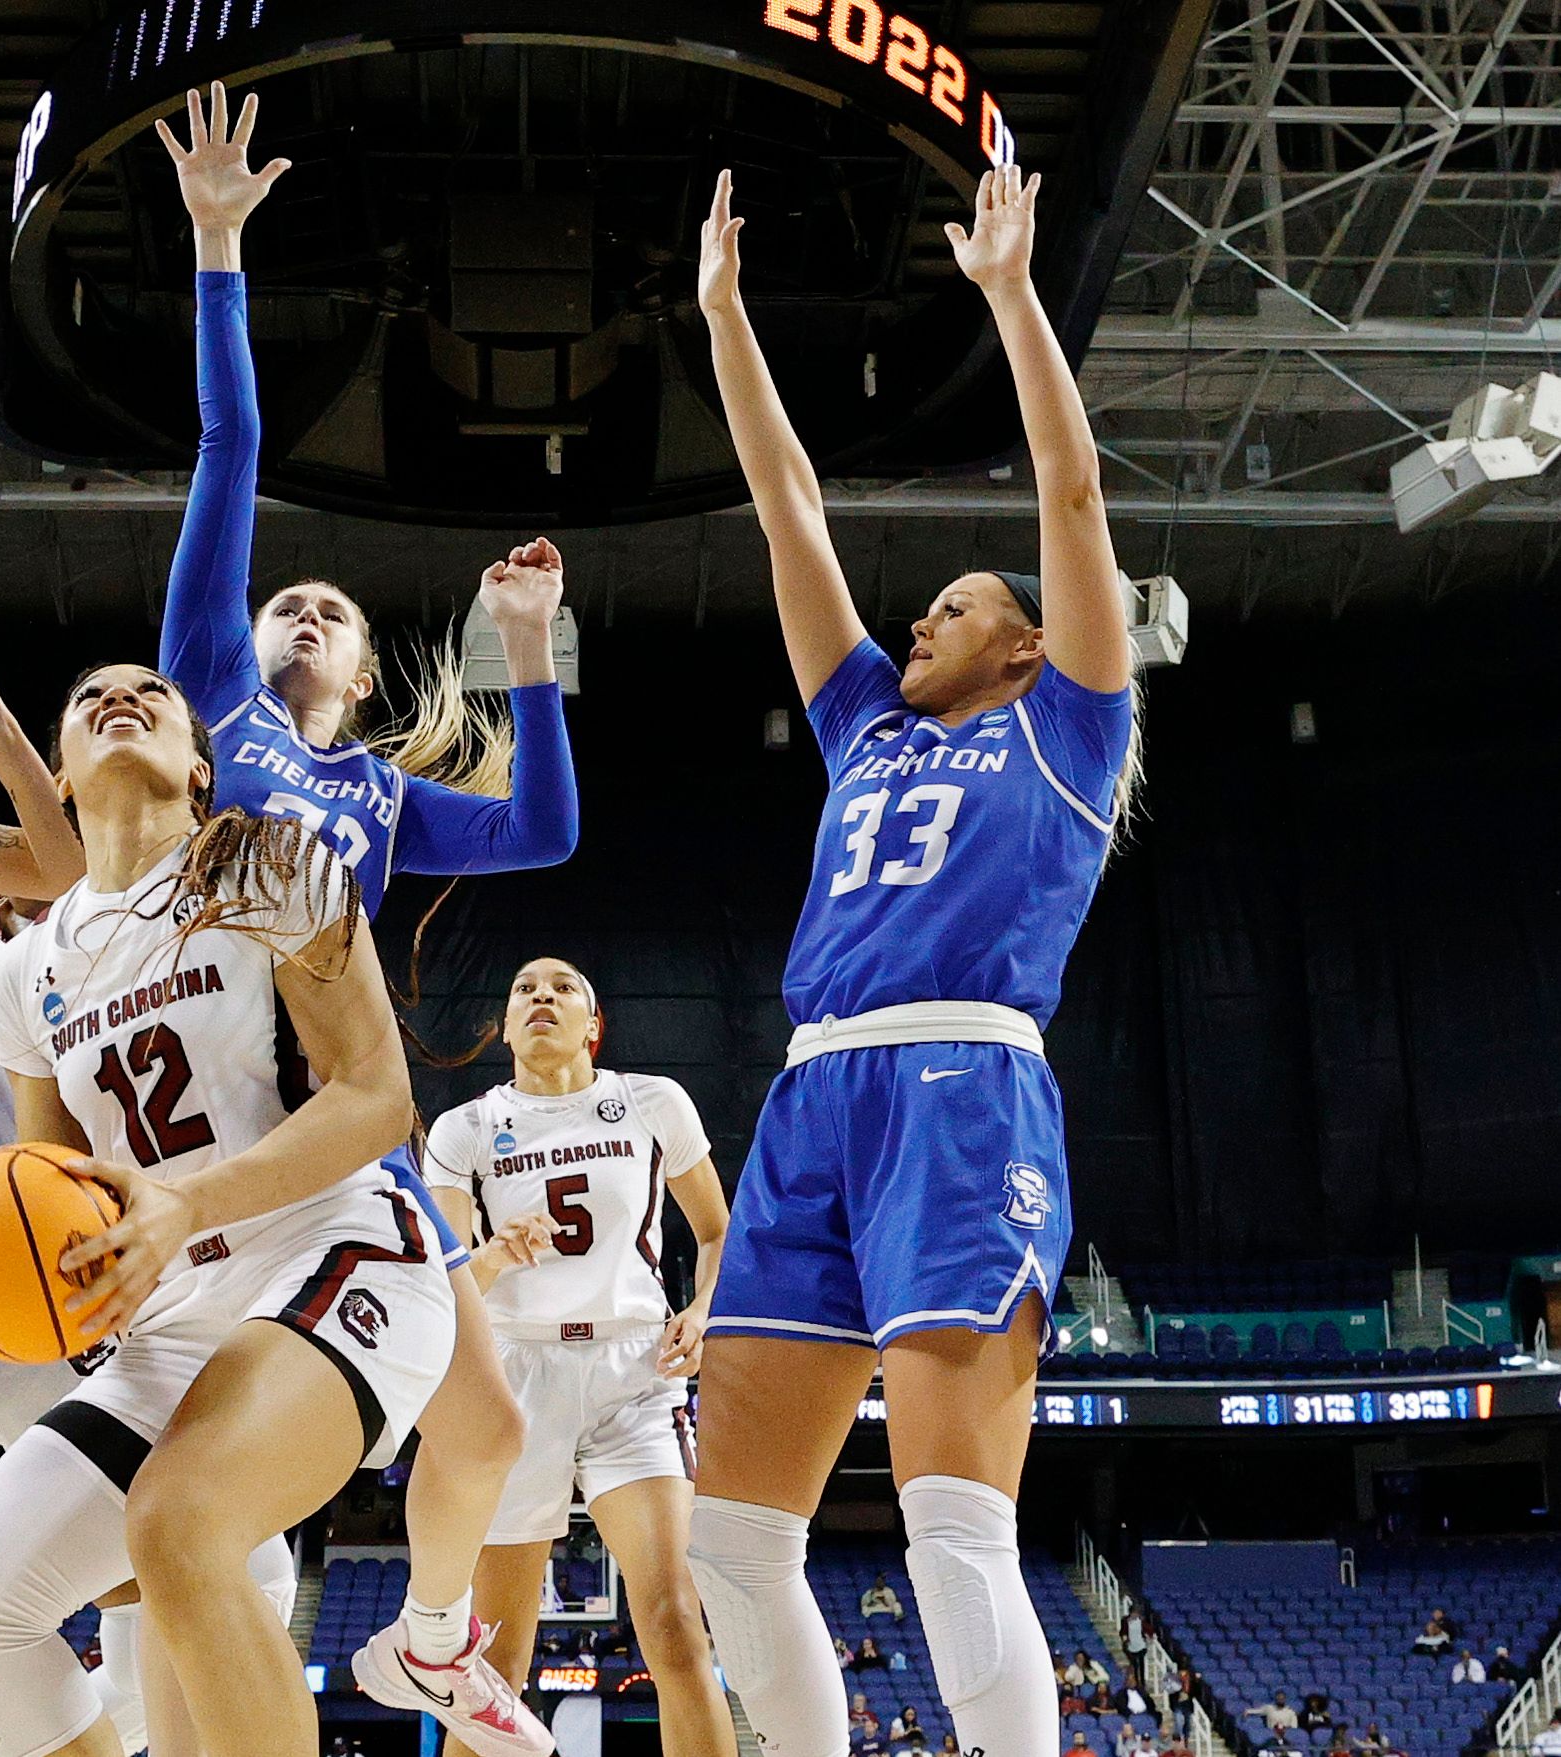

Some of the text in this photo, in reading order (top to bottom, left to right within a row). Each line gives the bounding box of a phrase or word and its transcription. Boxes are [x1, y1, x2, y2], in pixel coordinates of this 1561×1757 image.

[764, 0, 965, 126] 2022
[233, 741, 394, 829] CREIGHTO
[829, 784, 965, 897] 33
[52, 964, 224, 1060] SOUTH CAROLINA
[94, 1022, 216, 1168] 12
[493, 1140, 635, 1179] SOUTH CAROLINA
[546, 1173, 594, 1256] 5
[1294, 1396, 1323, 1422] 31
[1389, 1392, 1420, 1420] 33
